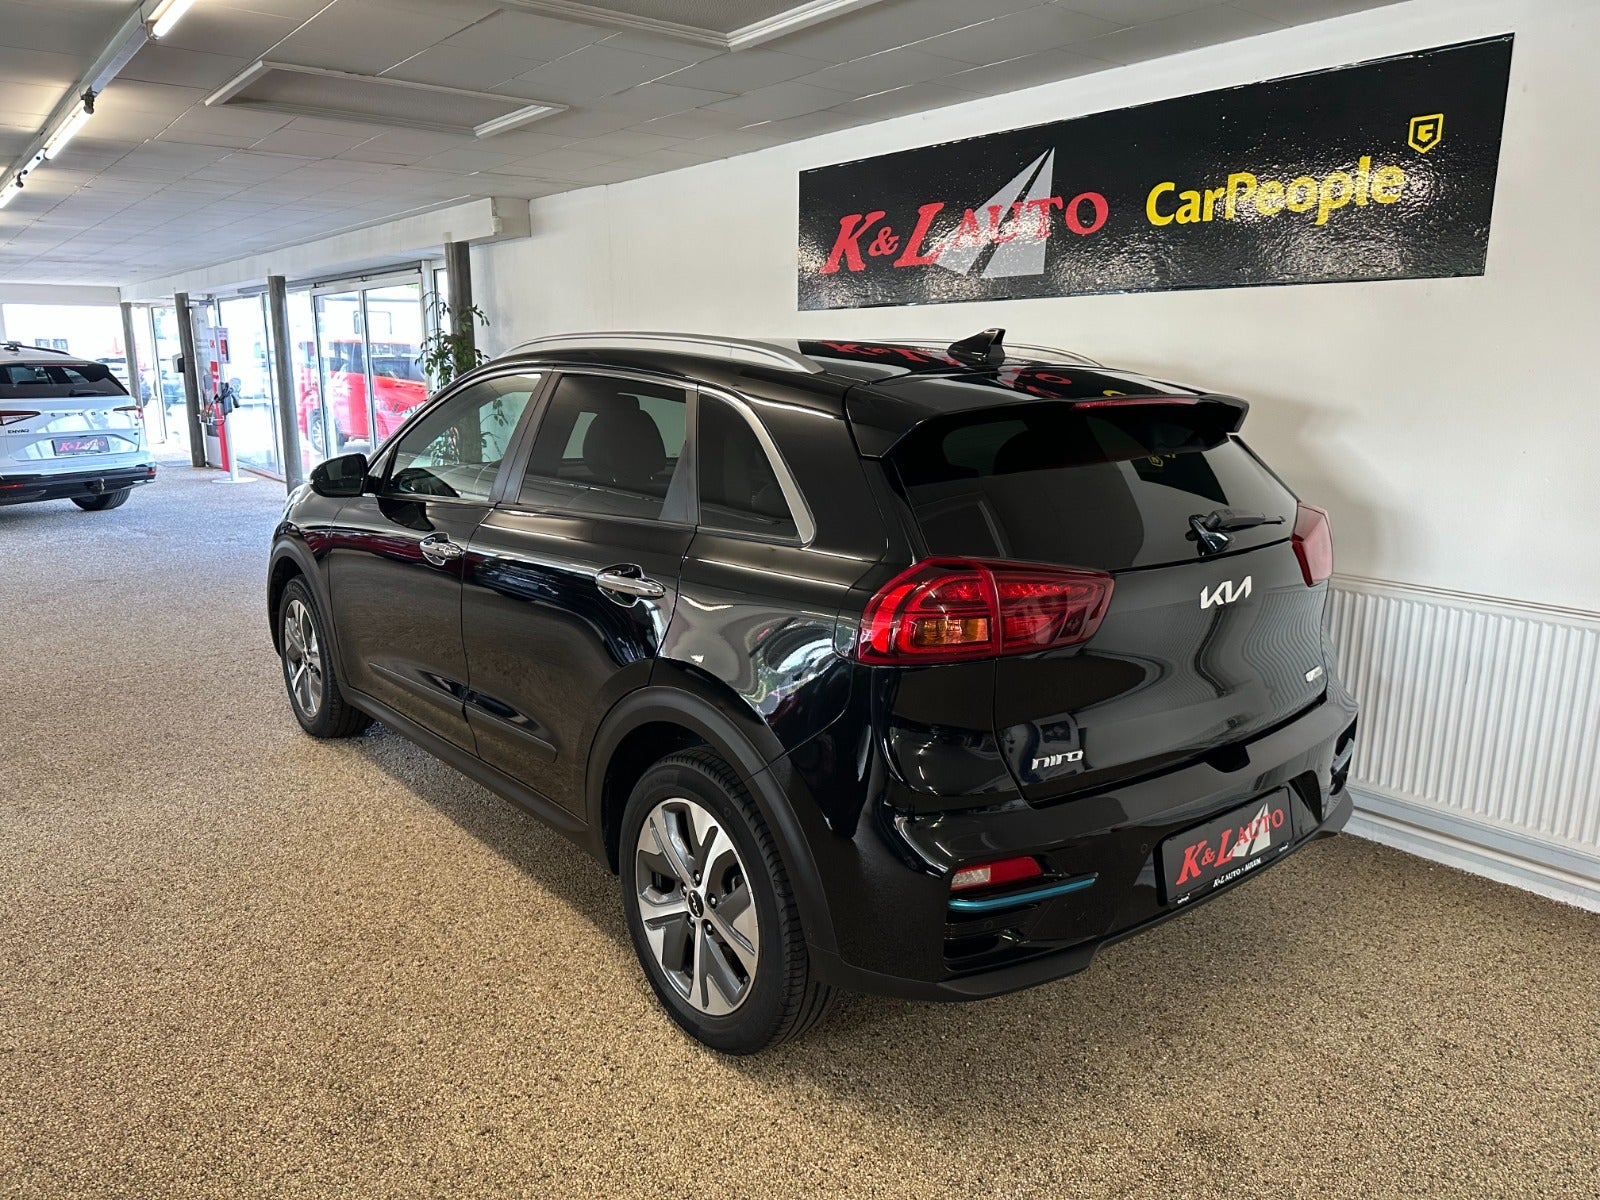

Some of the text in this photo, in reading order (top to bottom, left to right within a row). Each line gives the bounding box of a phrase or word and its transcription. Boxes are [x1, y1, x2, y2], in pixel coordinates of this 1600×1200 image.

[1145, 156, 1405, 226] CarPeople
[819, 191, 1109, 274] K&L AUTO
[1200, 575, 1252, 610] KIA
[1031, 750, 1084, 770] niro
[1175, 808, 1285, 886] K&L AUTO
